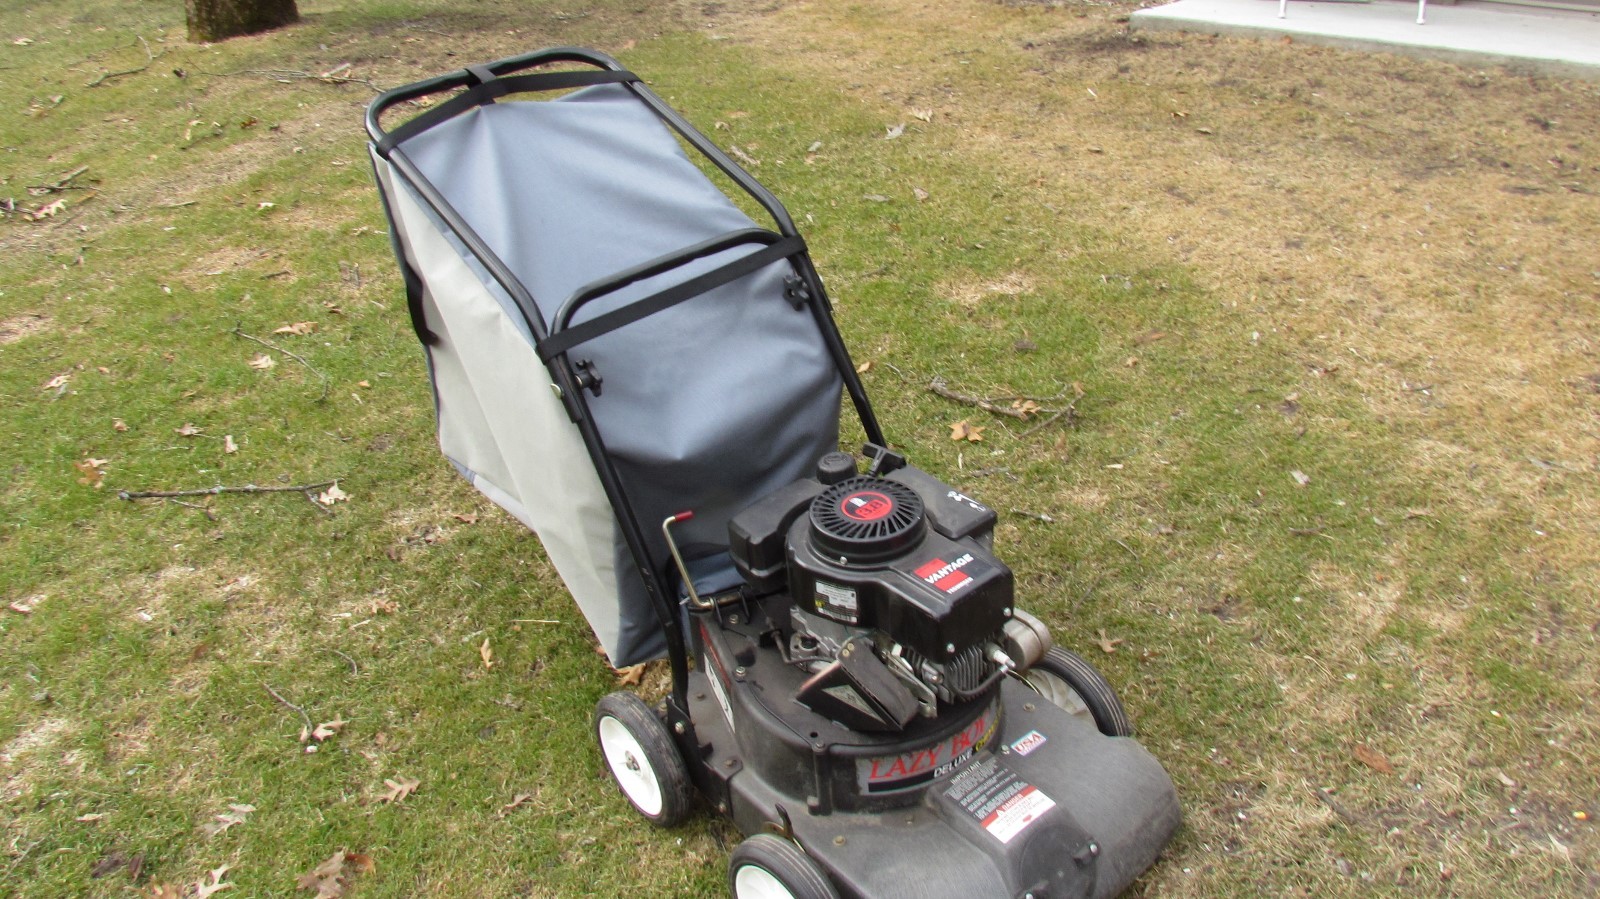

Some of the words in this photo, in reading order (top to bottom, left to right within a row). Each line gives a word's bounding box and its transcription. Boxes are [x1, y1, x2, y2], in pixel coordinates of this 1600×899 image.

[923, 553, 975, 584] VANTAGE
[1014, 732, 1042, 752] USA
[869, 742, 945, 780] LAZY
[933, 747, 974, 779] DELUXE
[949, 760, 983, 786] IMPORTANT
[1002, 793, 1025, 811] DANGER
